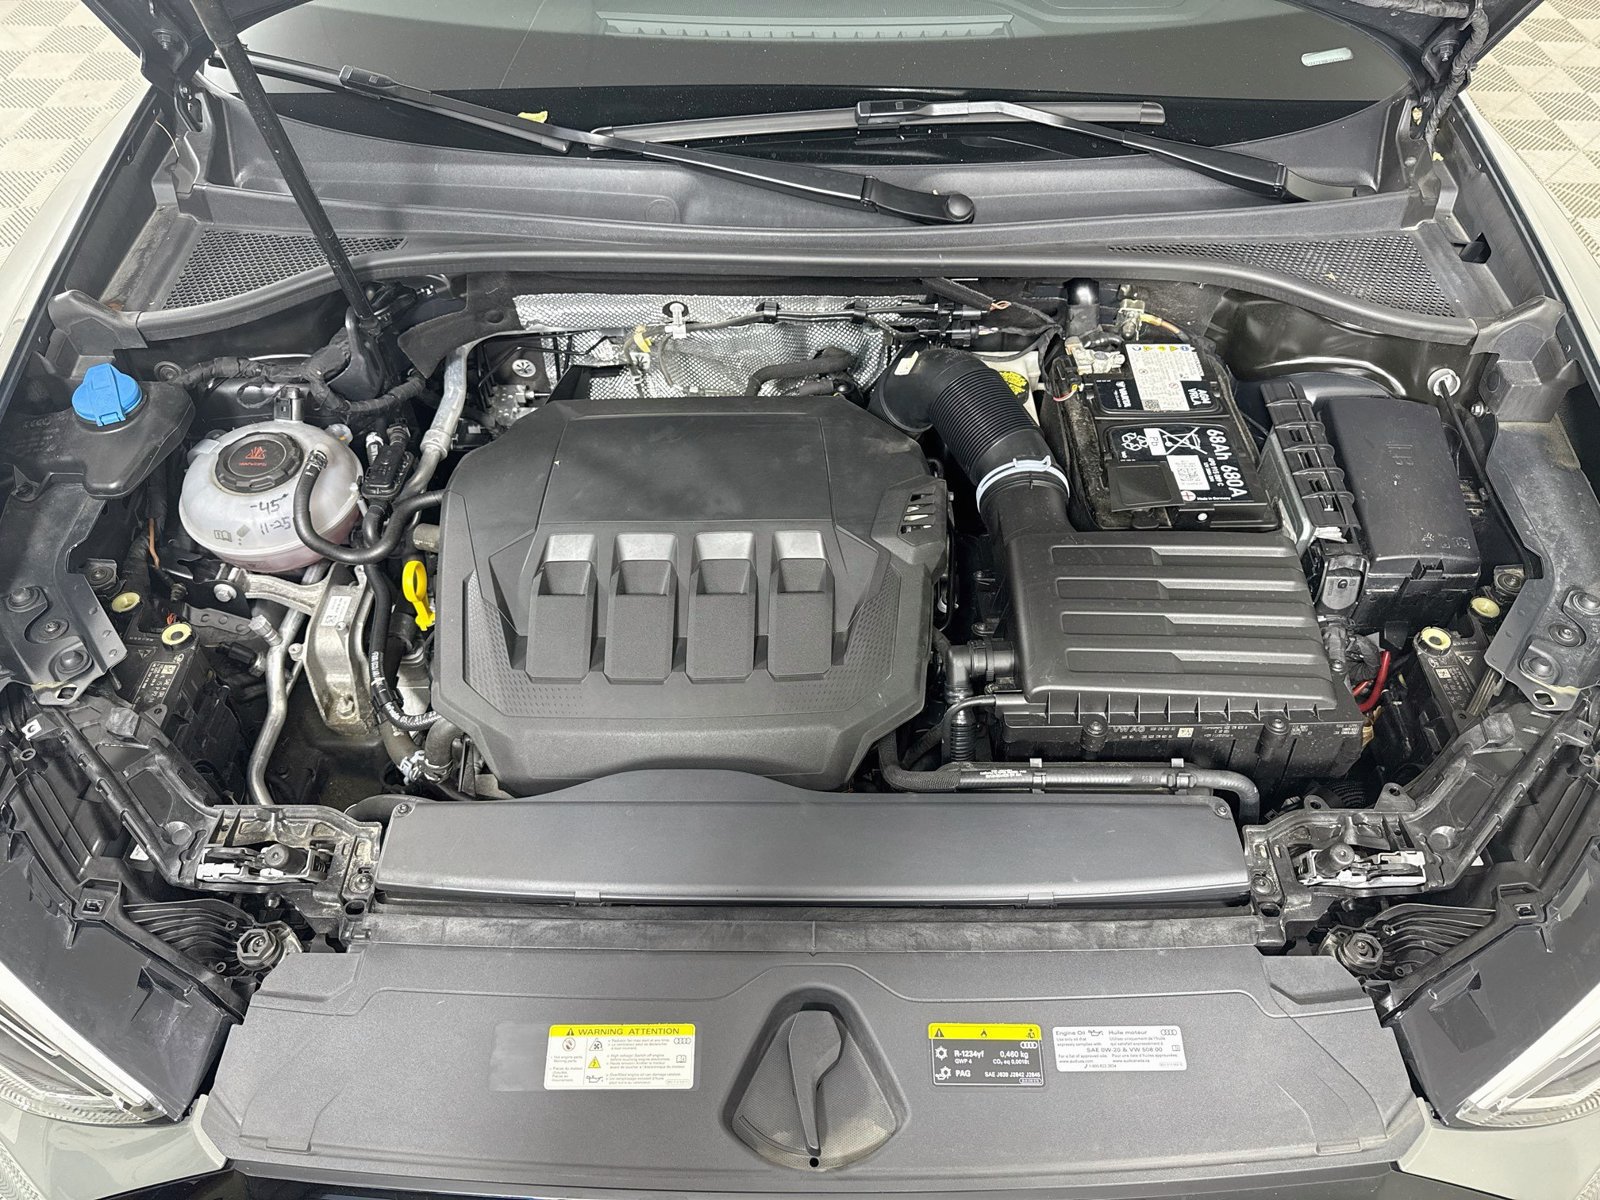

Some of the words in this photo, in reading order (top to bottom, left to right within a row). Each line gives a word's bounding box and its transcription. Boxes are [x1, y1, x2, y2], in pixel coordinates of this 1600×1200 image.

[1188, 388, 1201, 406] VRLA
[1198, 389, 1212, 404] AGM
[1149, 436, 1158, 447] Pb
[1206, 428, 1232, 460] 68Ah
[1220, 464, 1248, 498] 680A
[954, 1050, 984, 1058] R-1234yf
[1020, 1050, 1029, 1059] kg
